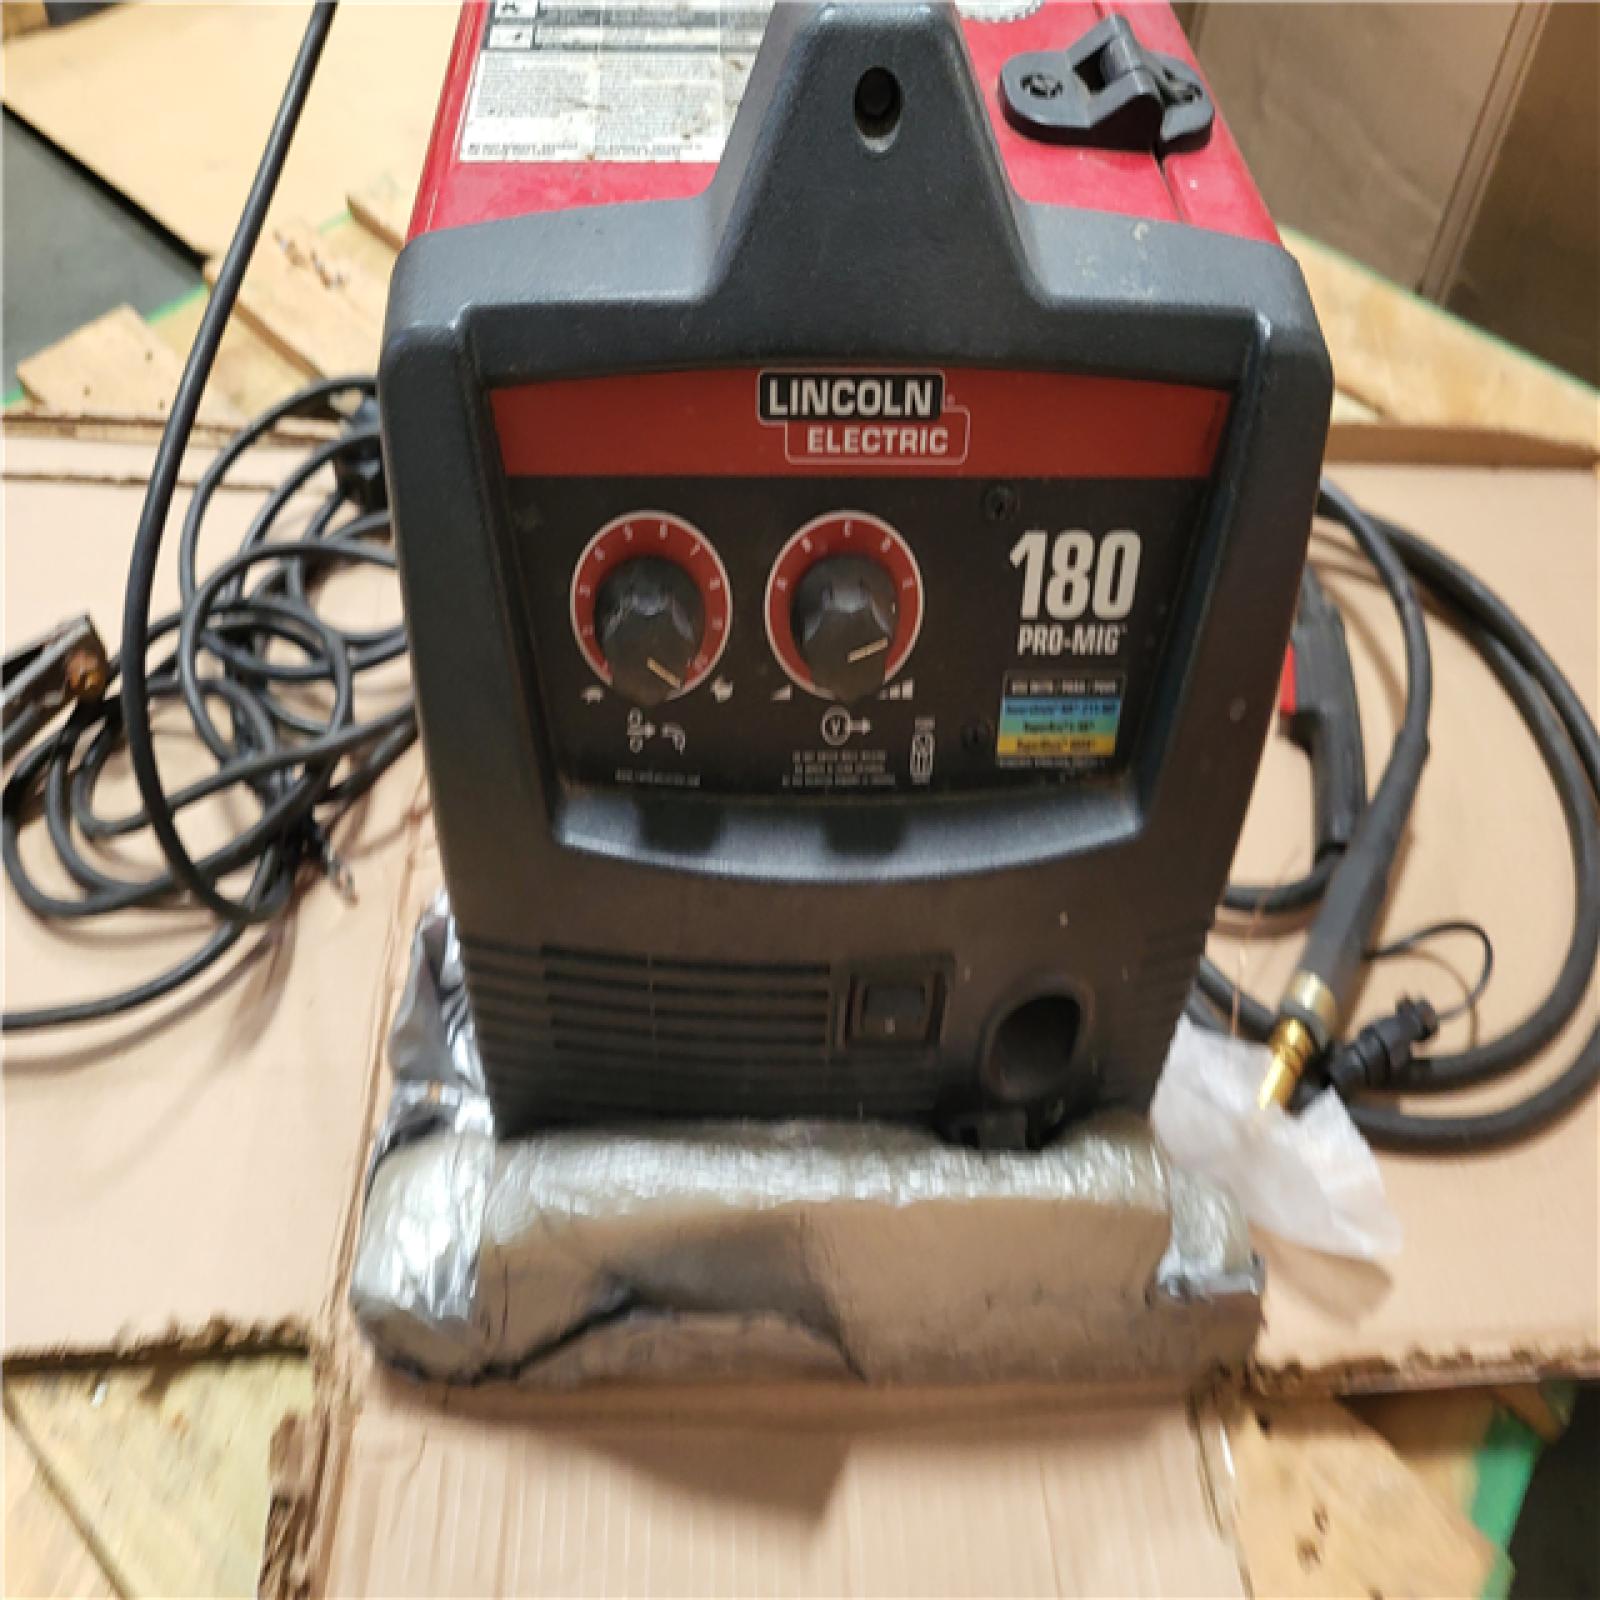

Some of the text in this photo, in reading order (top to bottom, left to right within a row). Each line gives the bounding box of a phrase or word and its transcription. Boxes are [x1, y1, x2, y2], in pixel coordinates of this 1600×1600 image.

[768, 379, 933, 416] LINCOLN
[807, 427, 949, 455] ELECTRIC
[1009, 529, 1142, 621] 180
[1017, 624, 1120, 656] PRO-MIG
